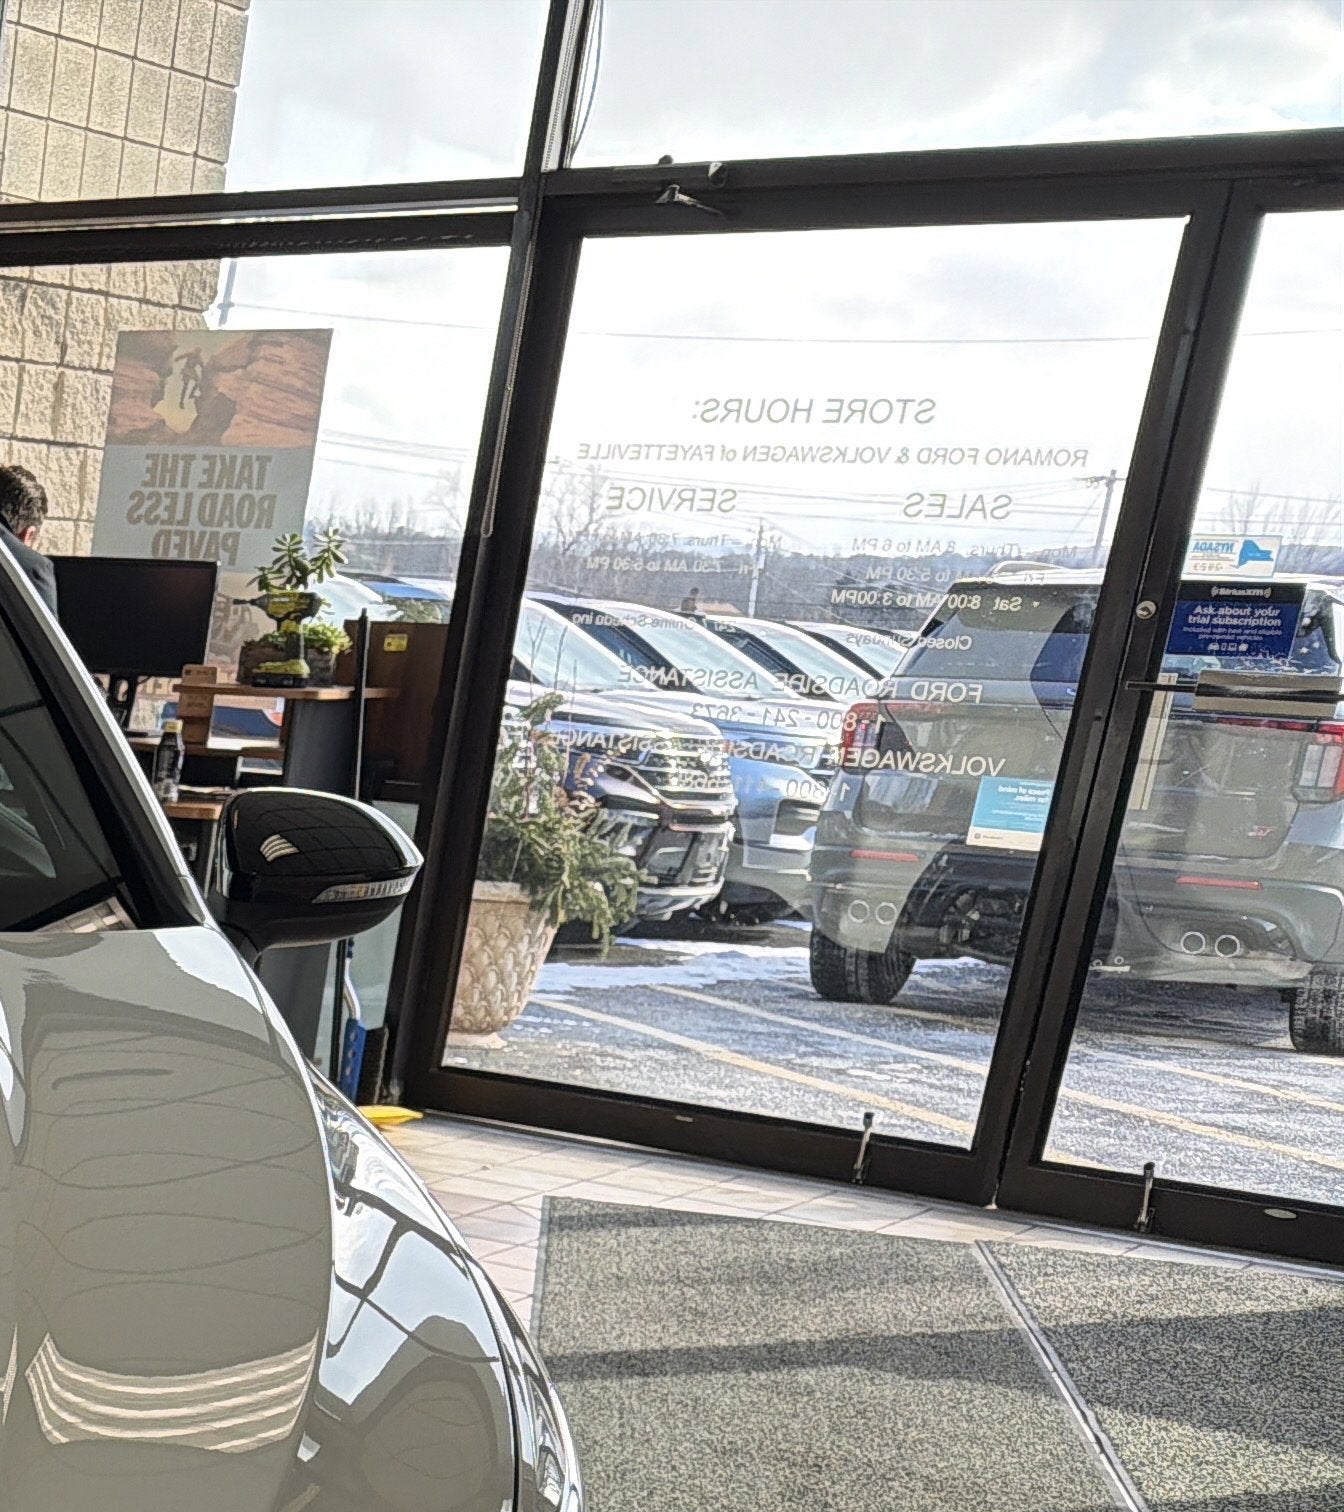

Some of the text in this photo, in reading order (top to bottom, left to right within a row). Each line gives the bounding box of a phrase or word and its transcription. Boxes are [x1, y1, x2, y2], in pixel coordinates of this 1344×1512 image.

[1193, 605, 1281, 618] Ask about your
[1187, 615, 1282, 627] trial subscription
